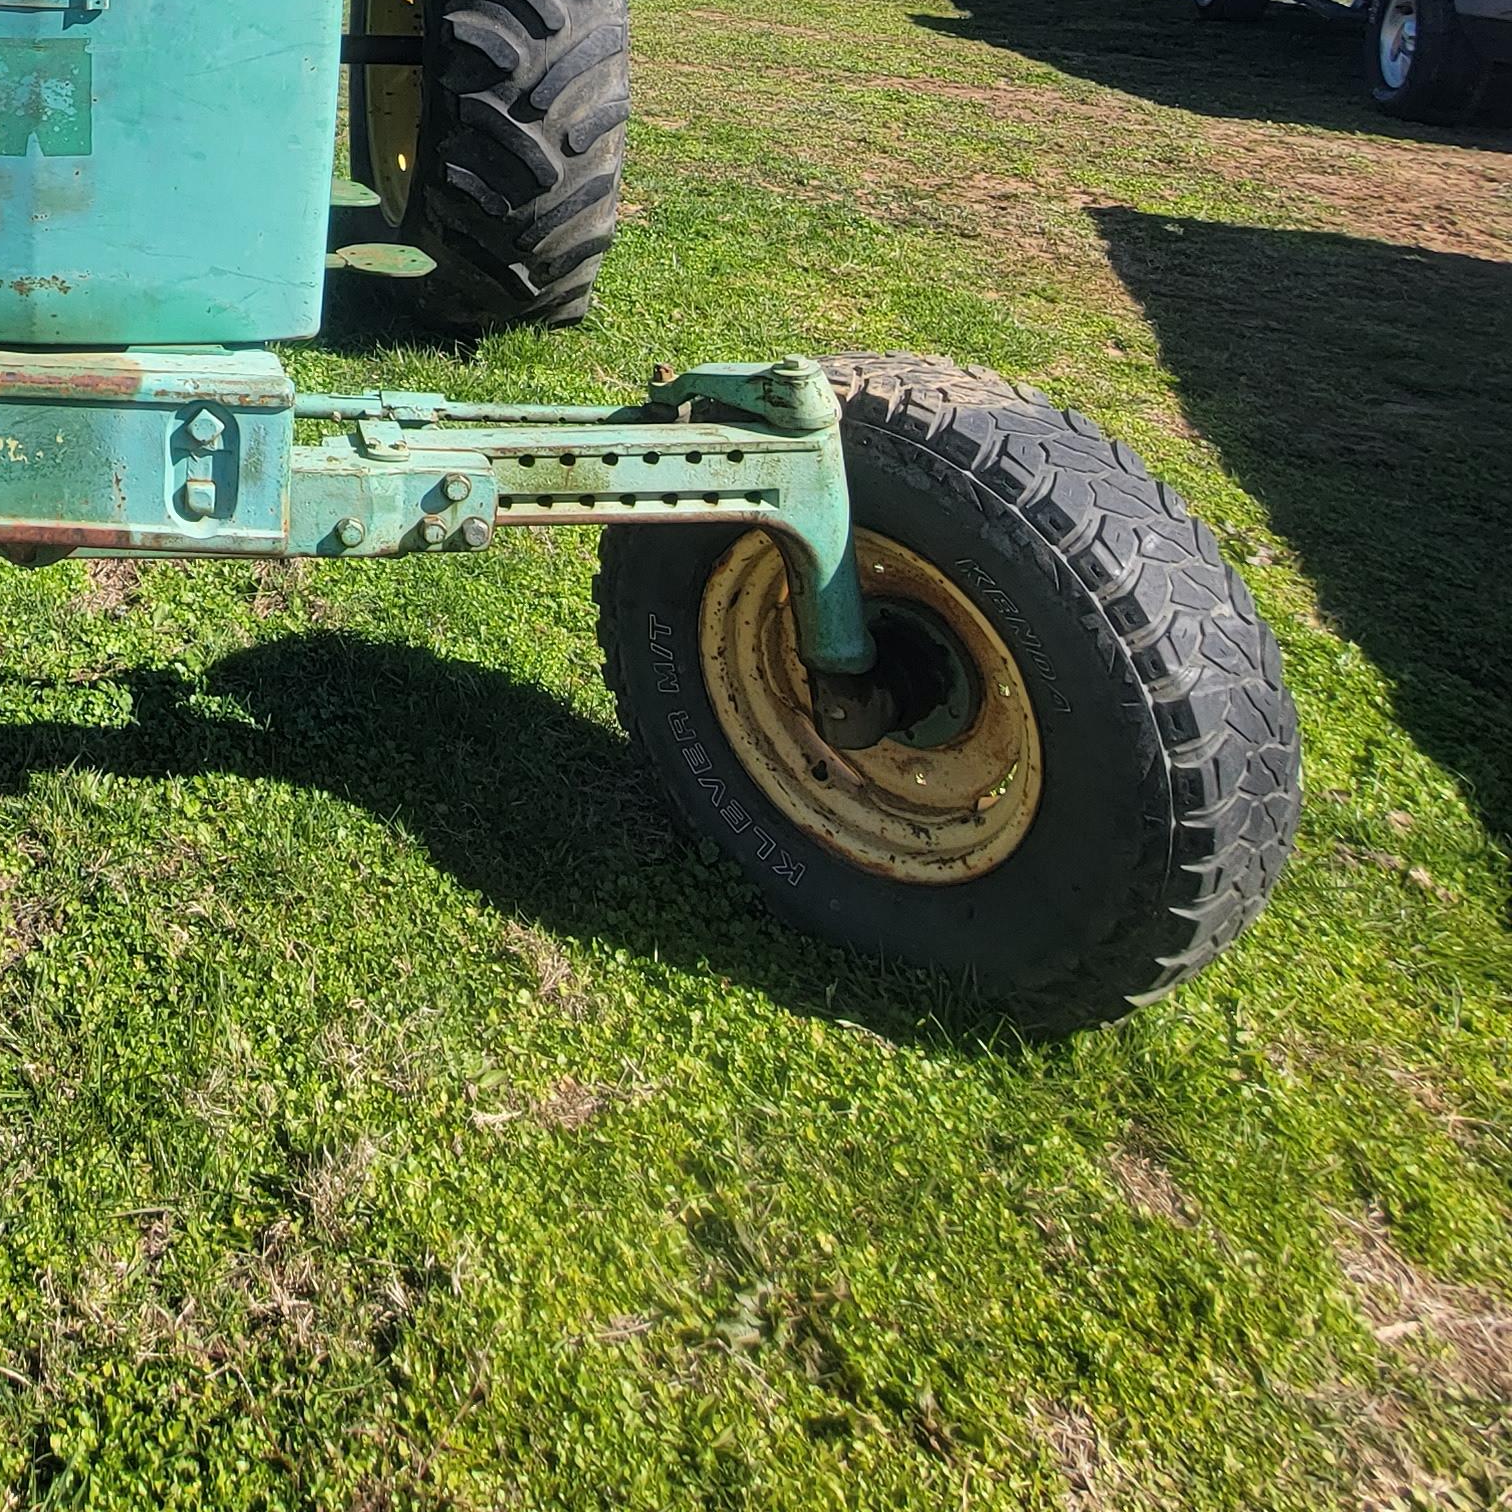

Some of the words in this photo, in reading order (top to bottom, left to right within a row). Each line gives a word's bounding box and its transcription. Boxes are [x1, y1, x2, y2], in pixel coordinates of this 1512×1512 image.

[648, 613, 680, 694] M/T
[954, 558, 1072, 713] KENDA
[667, 709, 806, 887] KLEVER
